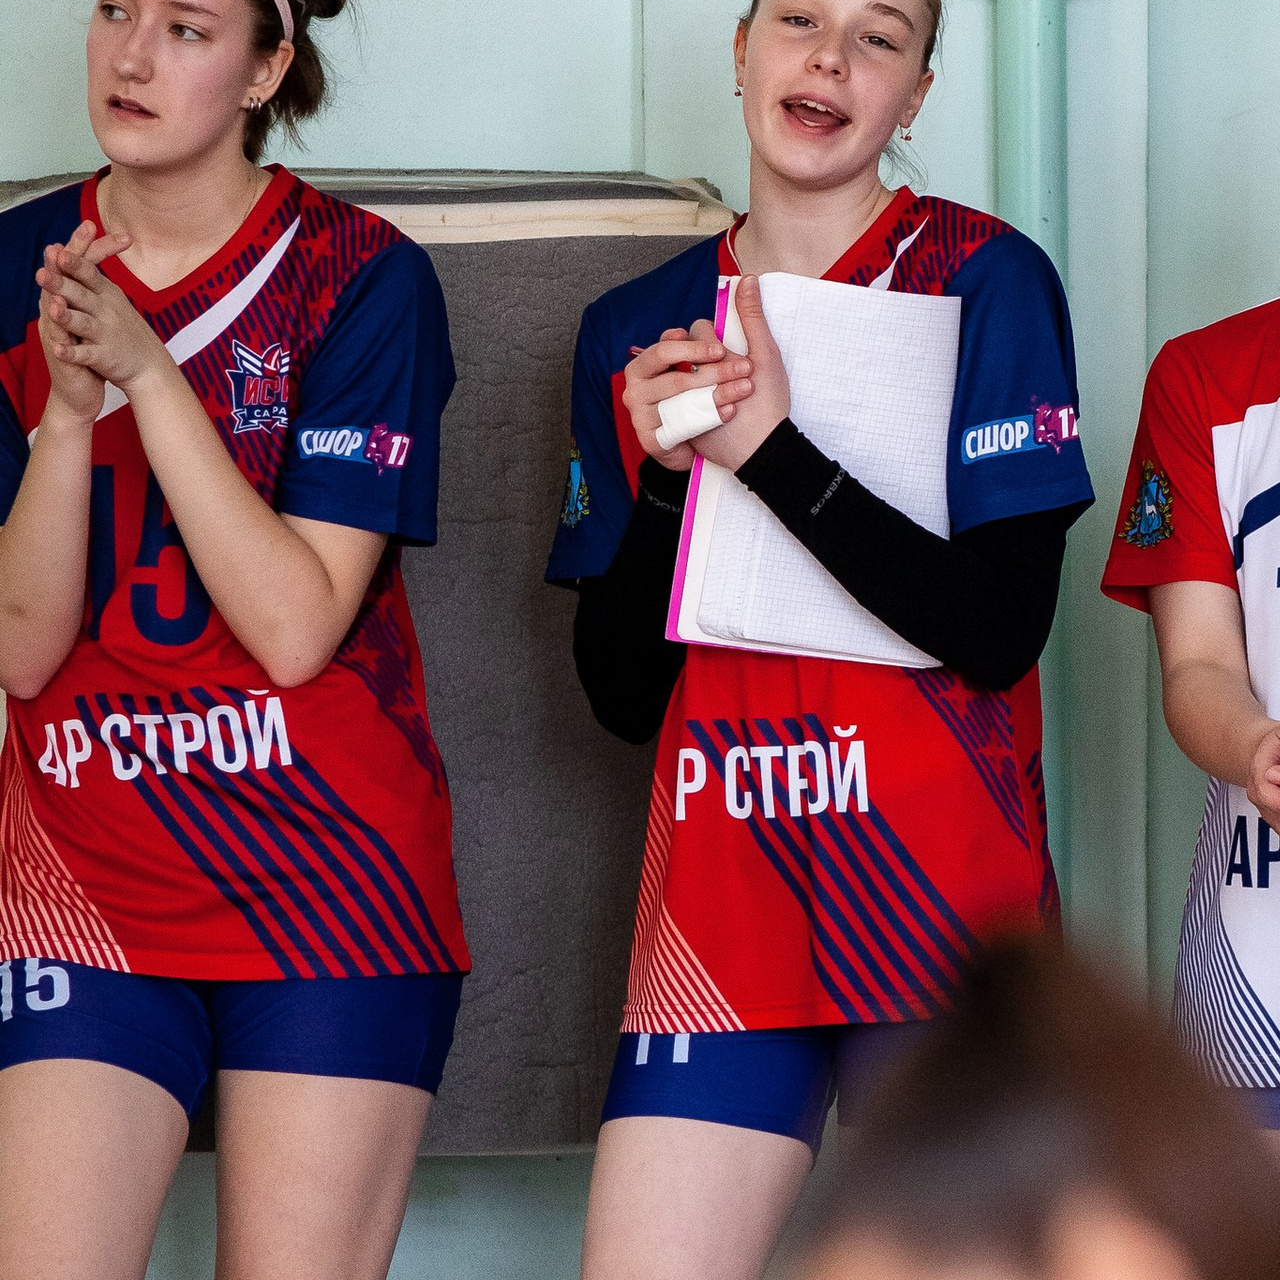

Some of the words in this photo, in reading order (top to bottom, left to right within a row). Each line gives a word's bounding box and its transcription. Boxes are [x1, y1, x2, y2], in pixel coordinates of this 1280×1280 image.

[301, 429, 363, 457] СШОР
[387, 436, 410, 466] 17
[965, 421, 1030, 459] СШОР
[100, 689, 292, 781] СТРОЙ
